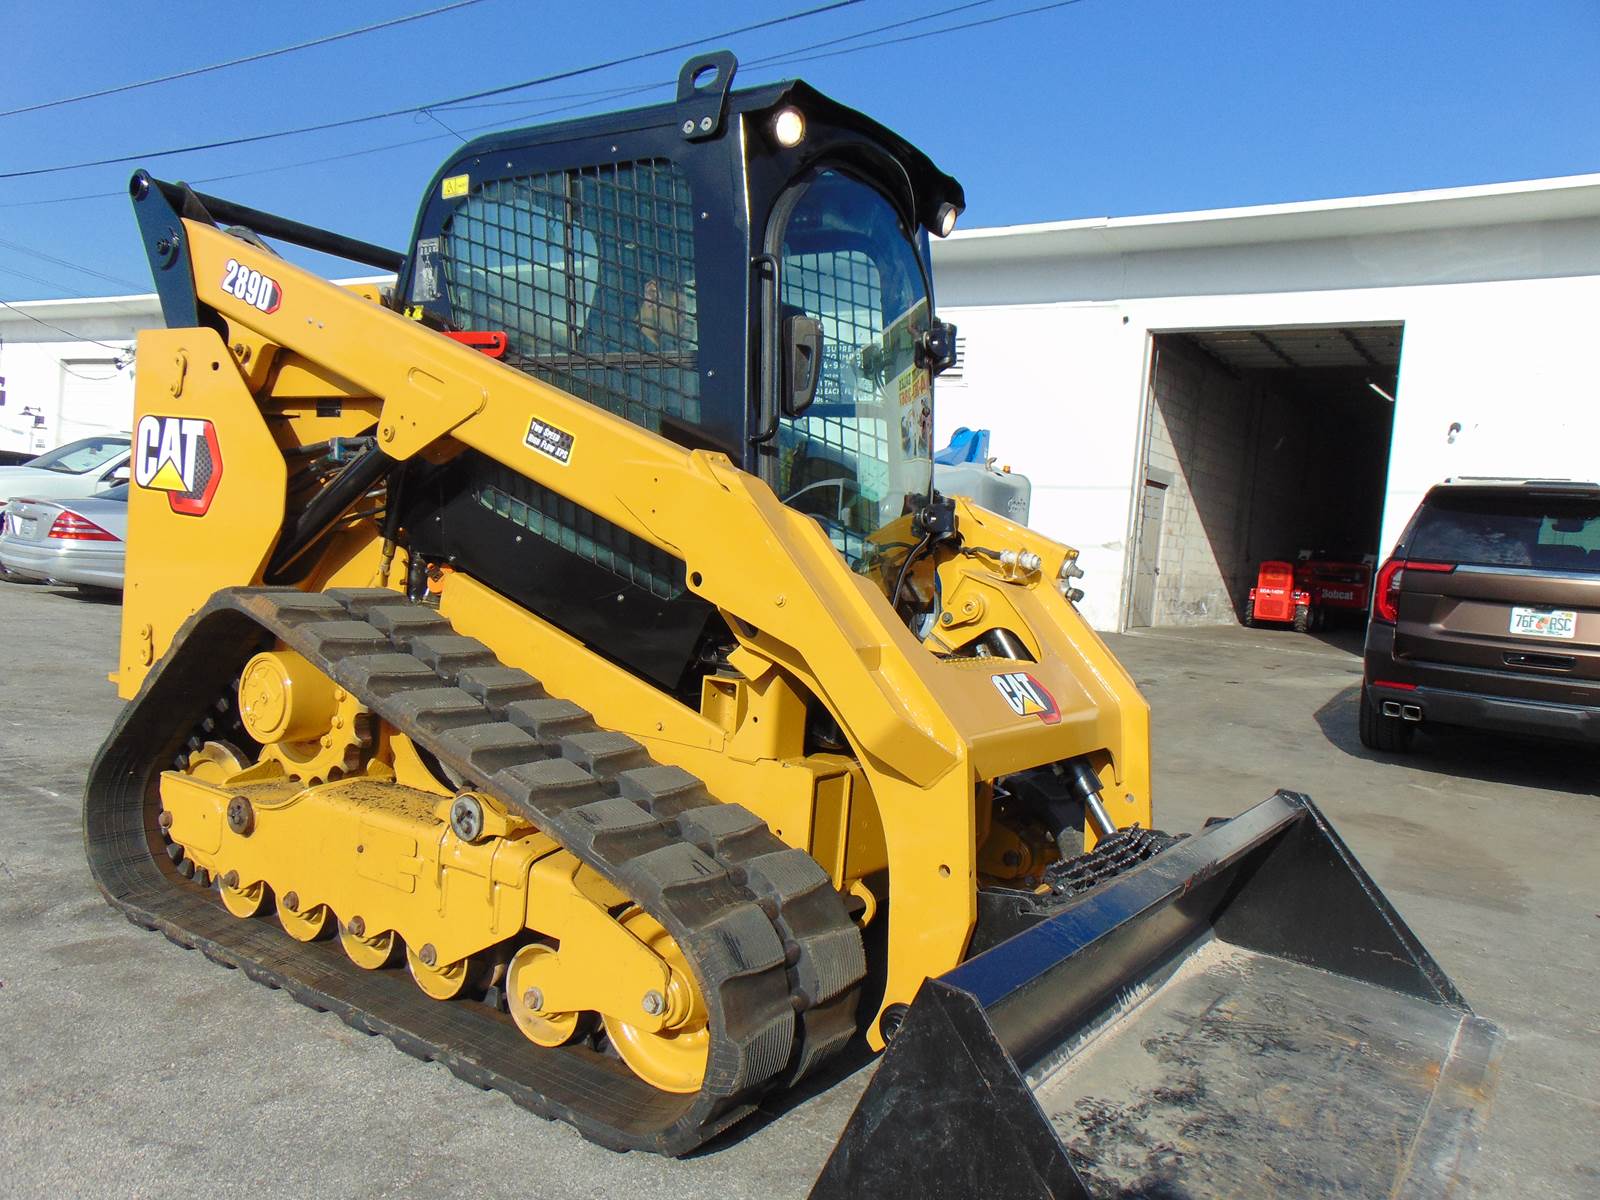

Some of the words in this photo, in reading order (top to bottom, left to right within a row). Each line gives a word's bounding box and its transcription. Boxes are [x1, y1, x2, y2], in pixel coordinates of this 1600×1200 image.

[221, 259, 274, 311] 289D
[135, 415, 205, 492] CAT
[1321, 588, 1354, 601] Bobcat
[991, 673, 1048, 715] CAT
